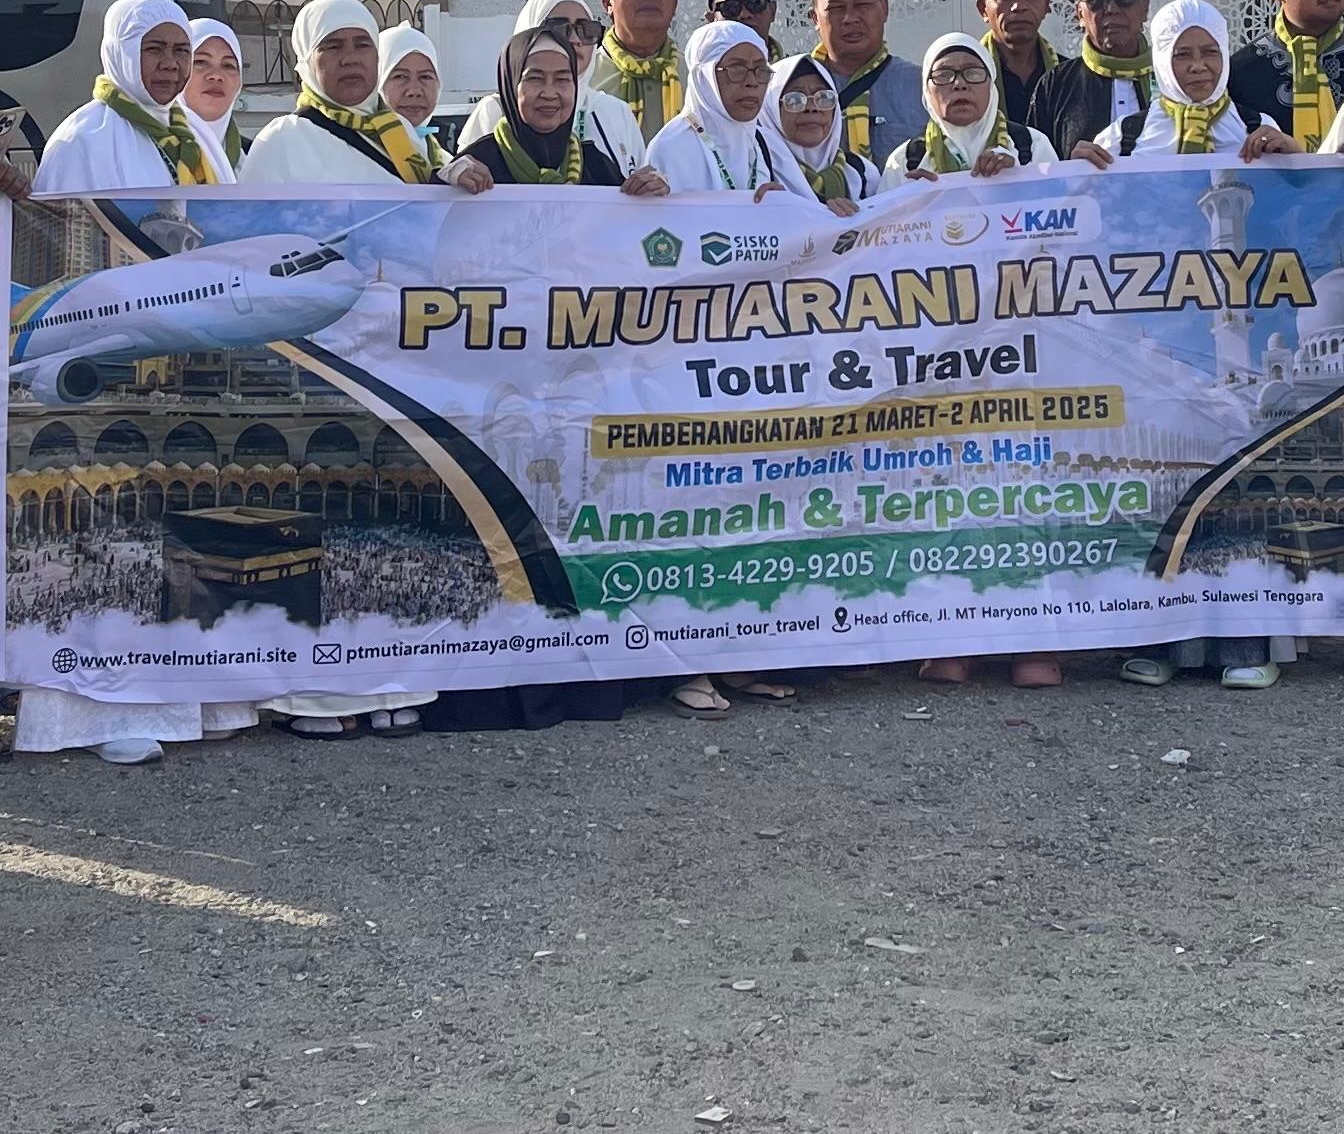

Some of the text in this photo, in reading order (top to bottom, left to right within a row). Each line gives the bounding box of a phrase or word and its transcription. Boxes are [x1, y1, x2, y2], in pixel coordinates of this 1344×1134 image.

[1025, 208, 1077, 232] KAN
[734, 235, 779, 249] SISKO
[735, 249, 779, 262] PATUH
[400, 248, 1317, 350] PT. MUTIARANI MAZAYA
[686, 334, 1038, 399] Tour & Travel
[607, 416, 824, 449] PEMBERANGKATAN
[831, 414, 859, 436] 21
[969, 399, 1035, 424] APRIL
[1042, 394, 1109, 420] 2025
[666, 436, 1052, 488] Mitra Terbaik Umroh & Haji
[568, 478, 1152, 543] Amanah & Terpercaya
[646, 538, 1119, 592] 0813-4229-9205 / 082292390267
[854, 612, 888, 627] Head
[893, 610, 933, 625] office,
[956, 607, 976, 619] MT
[982, 605, 1038, 621] Haryono
[1043, 603, 1062, 616] No
[1068, 601, 1095, 615] 110,
[1100, 598, 1154, 612] Lalolara,
[1158, 592, 1198, 609] Kambu,
[1202, 589, 1258, 602] Sulawesi
[1263, 589, 1324, 605] Tenggara
[346, 630, 609, 664] ptmutiaranimazaya@gmail.com
[654, 615, 820, 643] mutiarani_tour_travel
[79, 647, 297, 668] www.travelmutiarani.site
